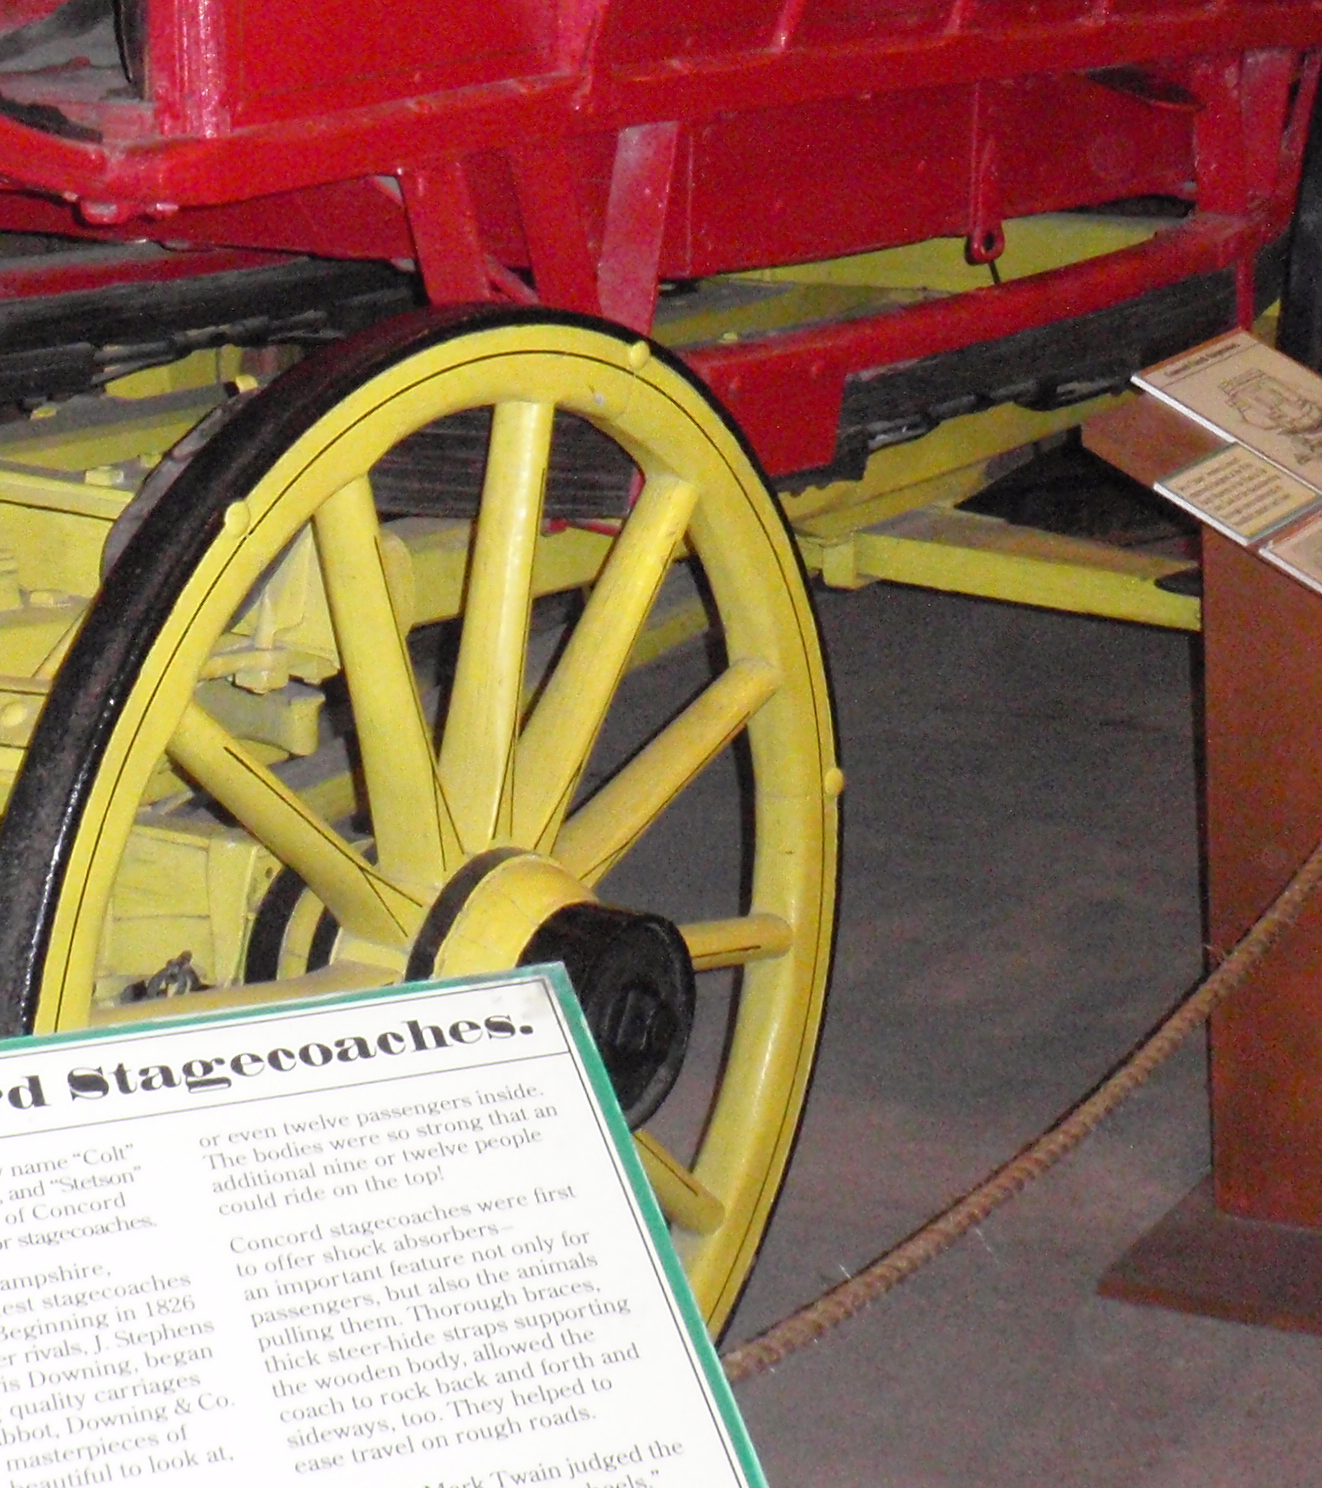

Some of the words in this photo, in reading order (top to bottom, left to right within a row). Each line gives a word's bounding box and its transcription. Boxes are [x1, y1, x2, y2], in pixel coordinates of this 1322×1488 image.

[66, 1013, 534, 1100] Stagecoaches.
[198, 1134, 221, 1148] or
[227, 1127, 277, 1144] even
[282, 1114, 349, 1136] twelve
[356, 1096, 473, 1128] passengers
[475, 1082, 544, 1106] inside.
[202, 1152, 247, 1170] The
[252, 1141, 324, 1163] bodies
[328, 1134, 380, 1151] were
[386, 1129, 410, 1142] so
[416, 1117, 484, 1138] strong
[487, 1107, 530, 1127] that
[533, 1105, 558, 1119] an
[10, 1159, 68, 1177] name
[212, 1161, 317, 1193] additional
[322, 1157, 368, 1176] nine
[374, 1153, 396, 1167] or
[402, 1141, 468, 1163] twelve
[474, 1127, 542, 1155] people
[4, 1207, 25, 1225] of
[31, 1191, 127, 1221] Concord
[8, 1180, 46, 1201] and
[218, 1191, 278, 1216] could
[283, 1185, 325, 1206] ride
[332, 1184, 359, 1198] on
[364, 1175, 398, 1193] the
[404, 1164, 444, 1186] top!
[229, 1223, 324, 1254] Concord
[329, 1204, 472, 1238] stagecoaches
[476, 1195, 528, 1213] were
[533, 1184, 576, 1205] first
[236, 1263, 258, 1278] to
[264, 1252, 315, 1273] offer
[322, 1238, 387, 1264] shock
[243, 1287, 270, 1302] an
[274, 1265, 384, 1296] important
[389, 1254, 465, 1277] feature
[471, 1244, 506, 1263] not
[511, 1234, 554, 1256] only
[561, 1230, 590, 1248] for
[41, 1274, 192, 1309] stagecoaches
[115, 1306, 137, 1323] in
[145, 1294, 196, 1318] 1826
[250, 1294, 381, 1329] passengers,
[384, 1283, 422, 1302] but
[428, 1275, 471, 1295] also
[475, 1268, 510, 1287] the
[516, 1251, 599, 1280] animals
[257, 1325, 335, 1354] pulling
[339, 1315, 403, 1335] them.
[405, 1289, 519, 1323] Thorough
[521, 1280, 601, 1303] braces,
[114, 1321, 215, 1348] Stephens
[143, 1346, 214, 1368] began
[264, 1349, 321, 1374] thick
[327, 1330, 435, 1363] steer-hide
[442, 1320, 509, 1343] straps
[513, 1298, 632, 1330] supporting
[271, 1379, 307, 1399] the
[314, 1364, 402, 1390] wooden
[405, 1350, 467, 1374] body,
[472, 1331, 556, 1363] allowed
[560, 1327, 594, 1347] the
[9, 1392, 85, 1421] quality
[94, 1374, 201, 1403] carriages
[279, 1396, 345, 1423] coach
[351, 1395, 374, 1410] to
[380, 1381, 431, 1406] rock
[434, 1370, 489, 1395] back
[494, 1360, 536, 1385] and
[540, 1351, 595, 1376] forth
[600, 1341, 641, 1365] and
[65, 1405, 169, 1435] Downing
[173, 1398, 192, 1416] &
[286, 1419, 396, 1449] sideways,
[401, 1411, 444, 1428] too.
[445, 1397, 504, 1418] They
[510, 1377, 586, 1407] helped
[590, 1377, 613, 1393] to
[294, 1454, 344, 1474] ease
[351, 1435, 415, 1464] travel
[421, 1434, 449, 1450] on
[455, 1416, 523, 1445] rough
[528, 1404, 596, 1431] roads.
[6, 1434, 160, 1472] masterpieces
[166, 1423, 187, 1442] of
[489, 1463, 561, 1488] Twain
[566, 1444, 644, 1479] judged
[647, 1440, 683, 1460] the
